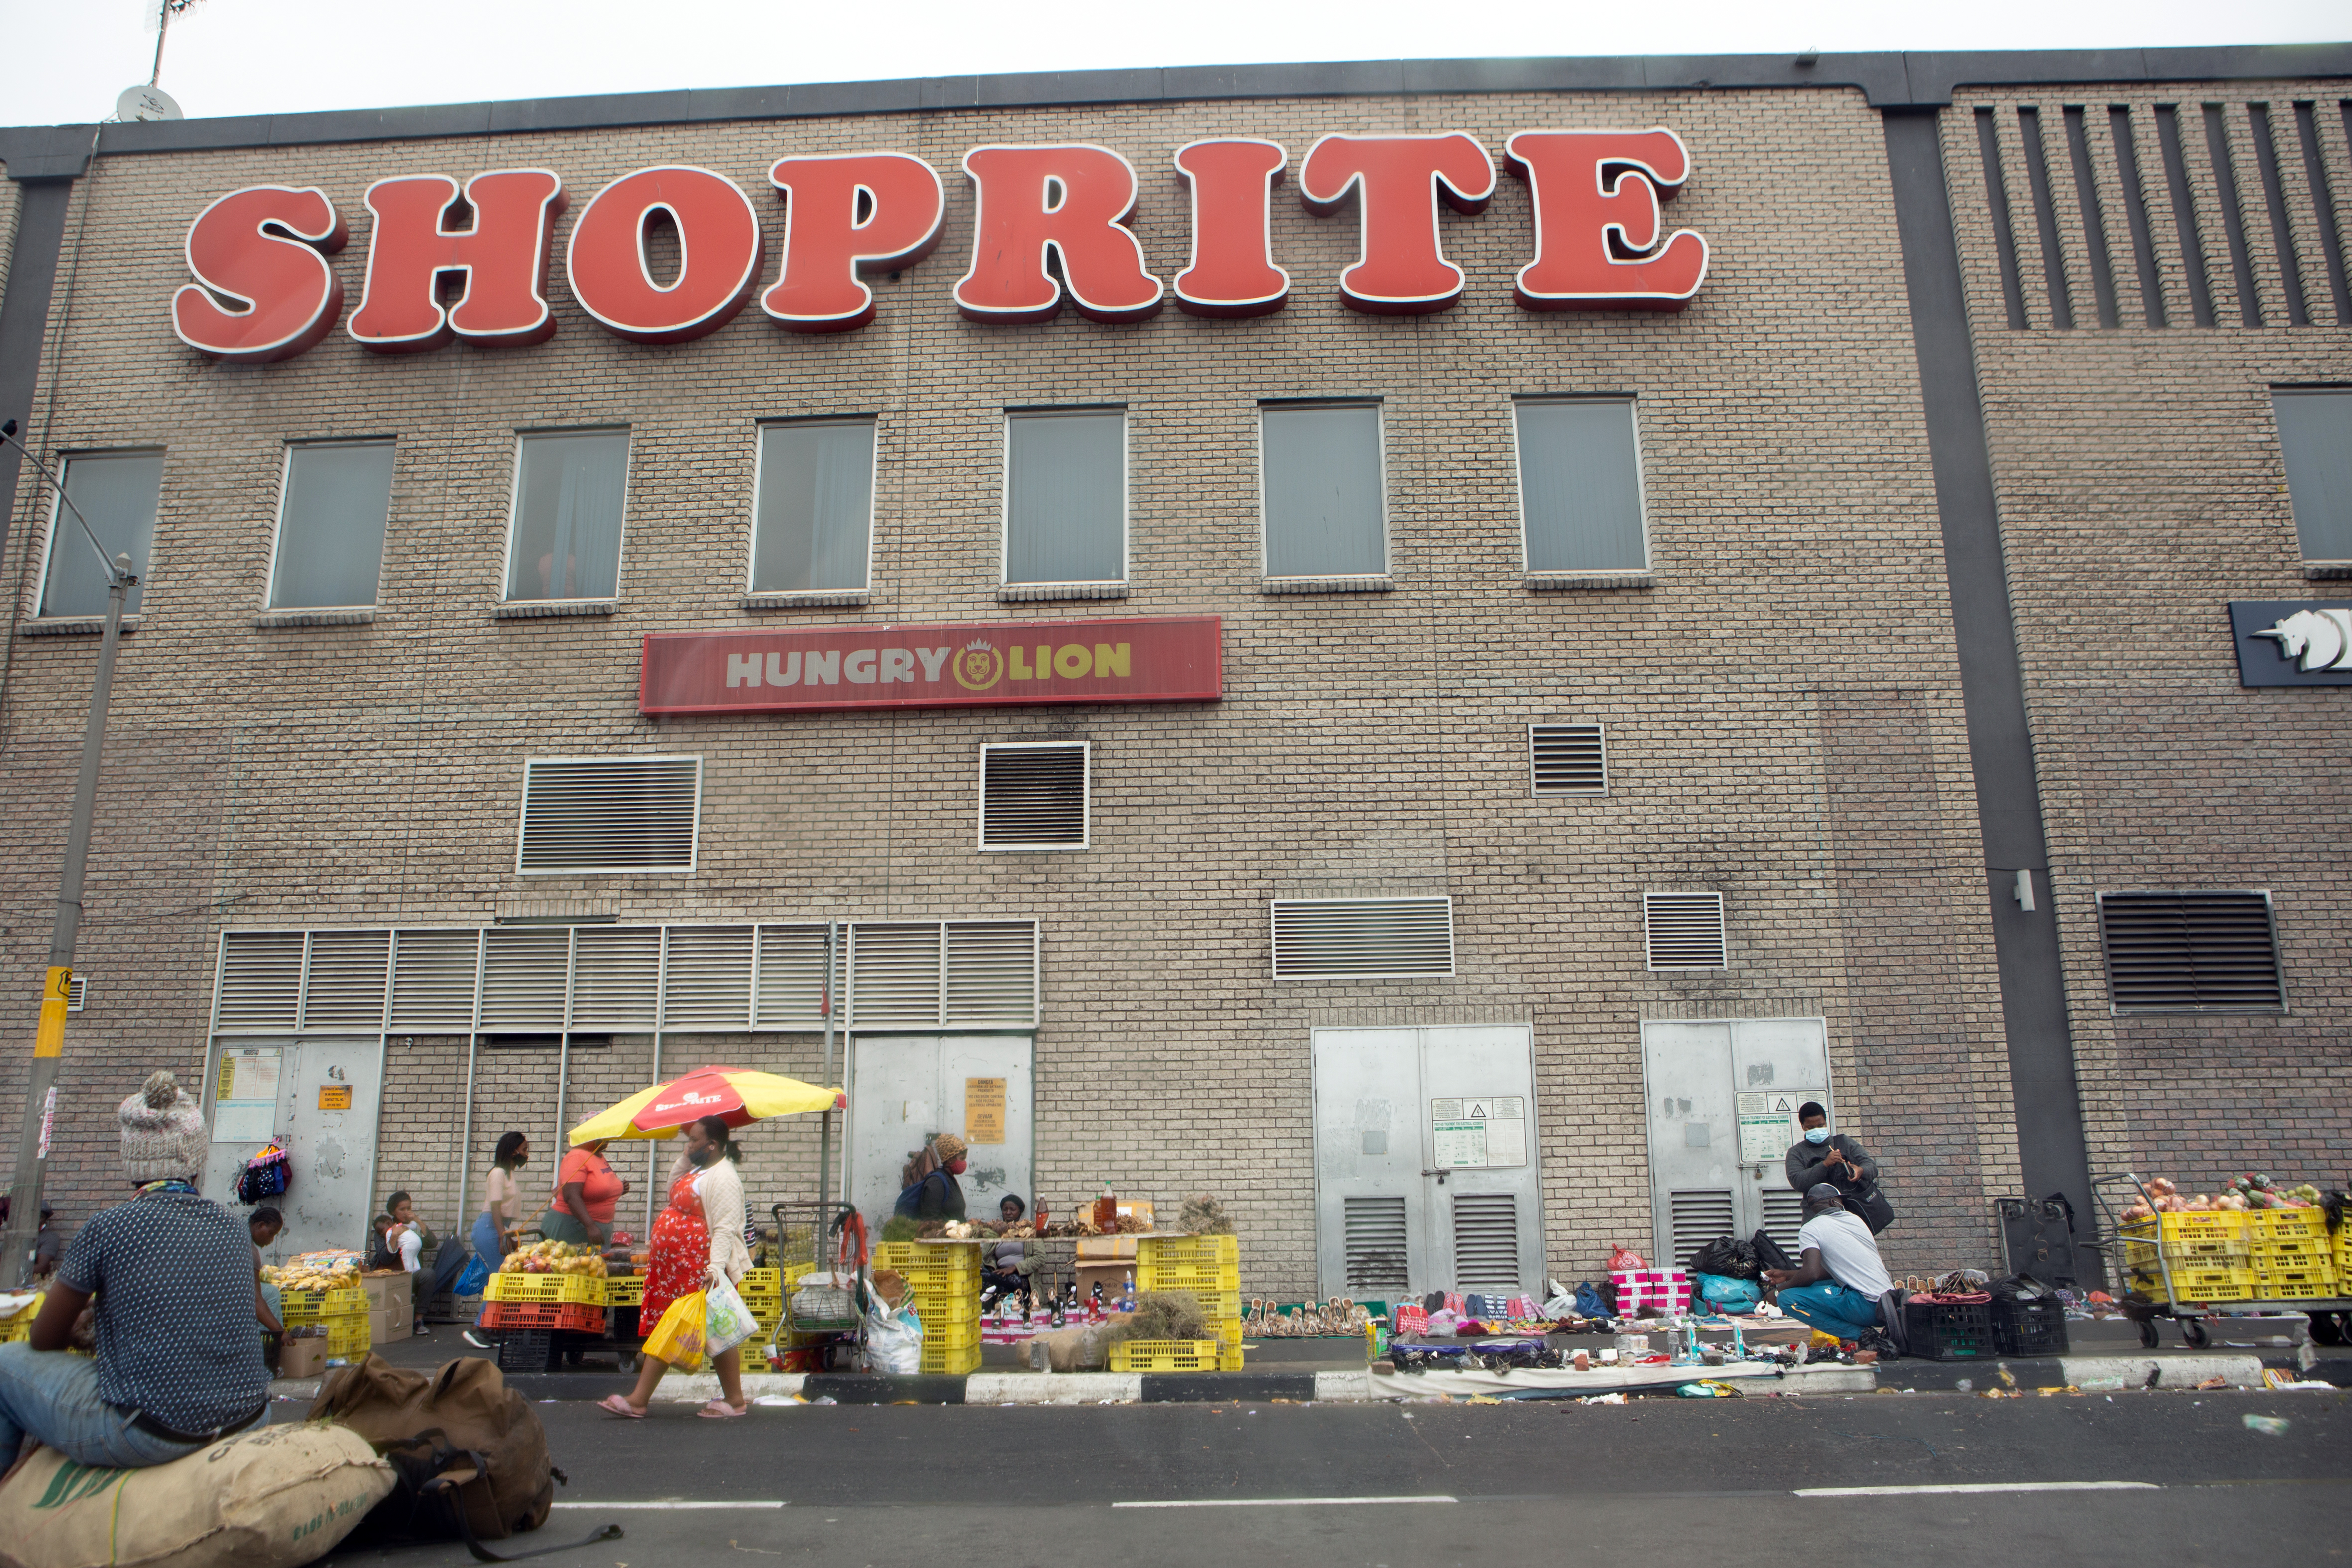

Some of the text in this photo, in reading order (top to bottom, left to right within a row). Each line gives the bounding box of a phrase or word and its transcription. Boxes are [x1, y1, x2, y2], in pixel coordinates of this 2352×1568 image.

[172, 126, 1711, 359] SHOPRITE
[726, 642, 1131, 688] HUNGRY LION
